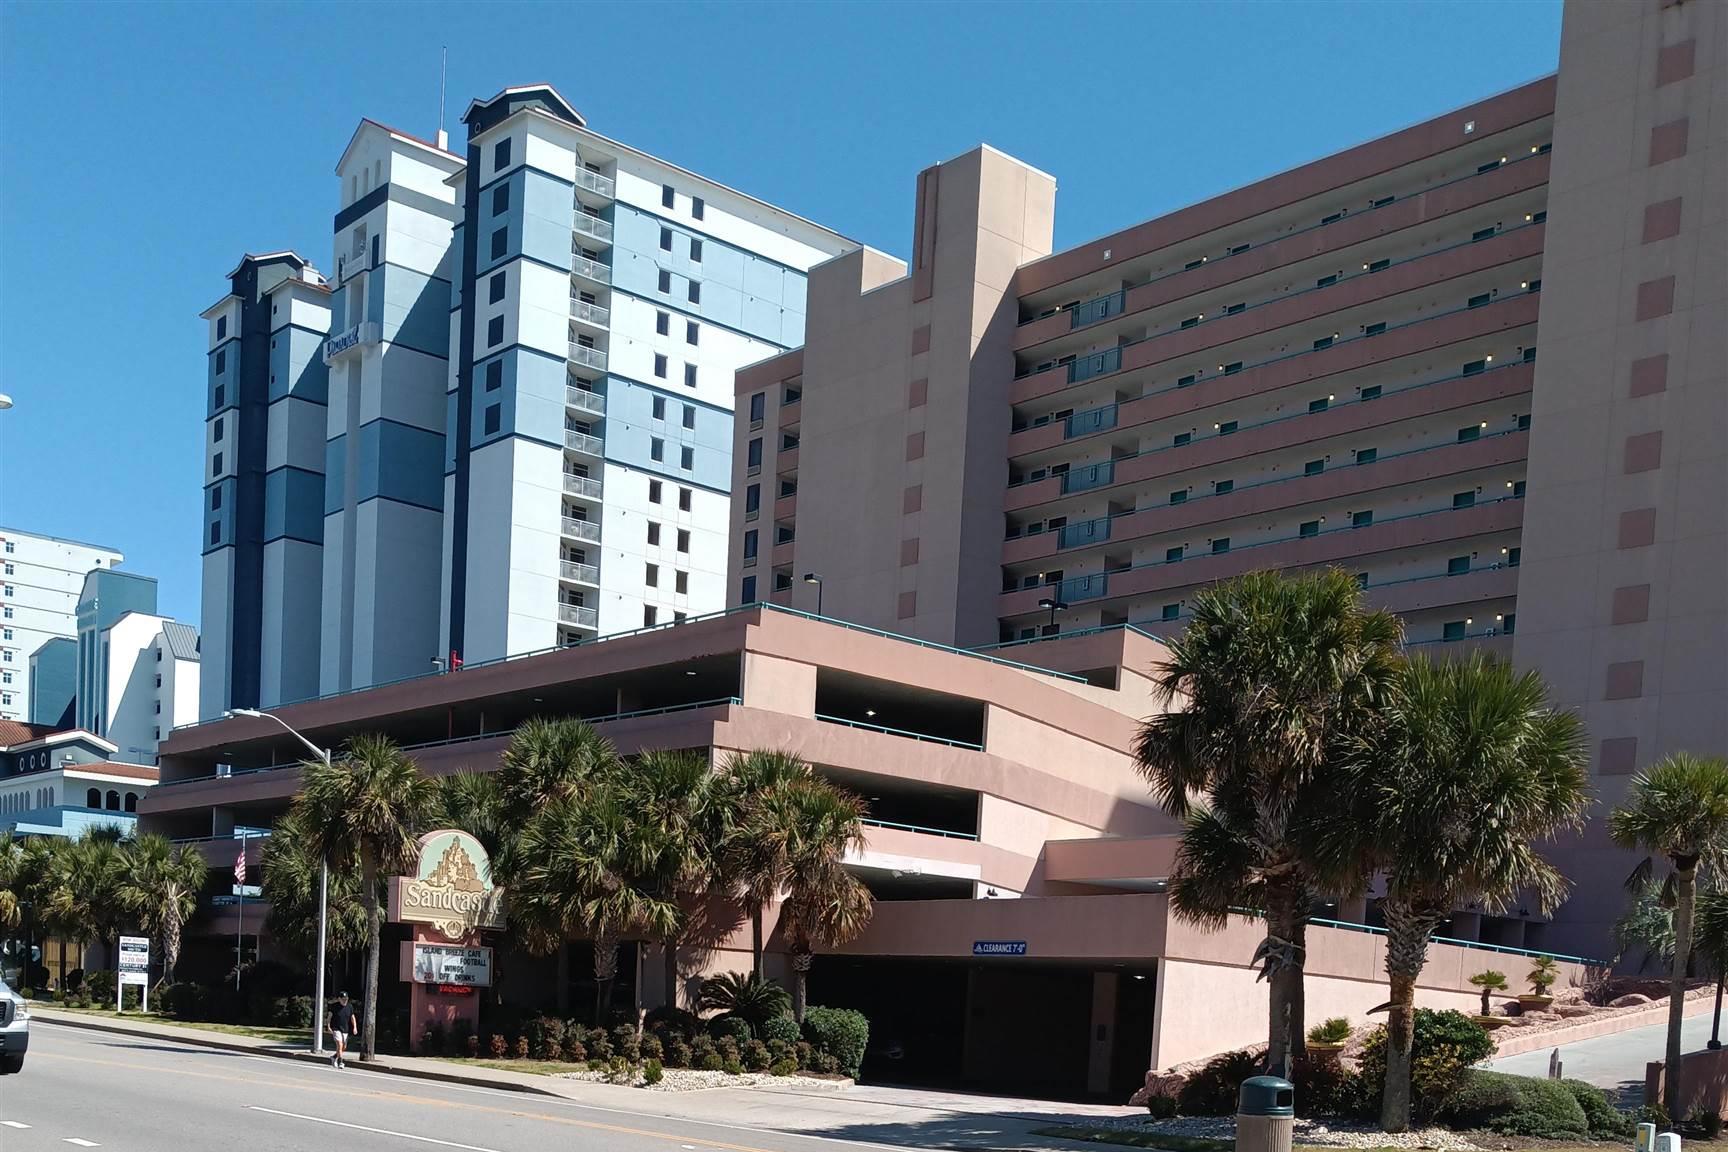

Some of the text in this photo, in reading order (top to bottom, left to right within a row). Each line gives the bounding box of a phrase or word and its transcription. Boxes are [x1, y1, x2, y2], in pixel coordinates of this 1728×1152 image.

[405, 884, 504, 914] Sandcase
[423, 947, 481, 958] ISLAND BREEZE CAFE
[983, 943, 1012, 953] CLEARANCE
[460, 958, 487, 967] FOOTBALL
[444, 965, 465, 974] WINGS
[439, 972, 450, 981] OFF
[454, 973, 476, 982] DRINKS
